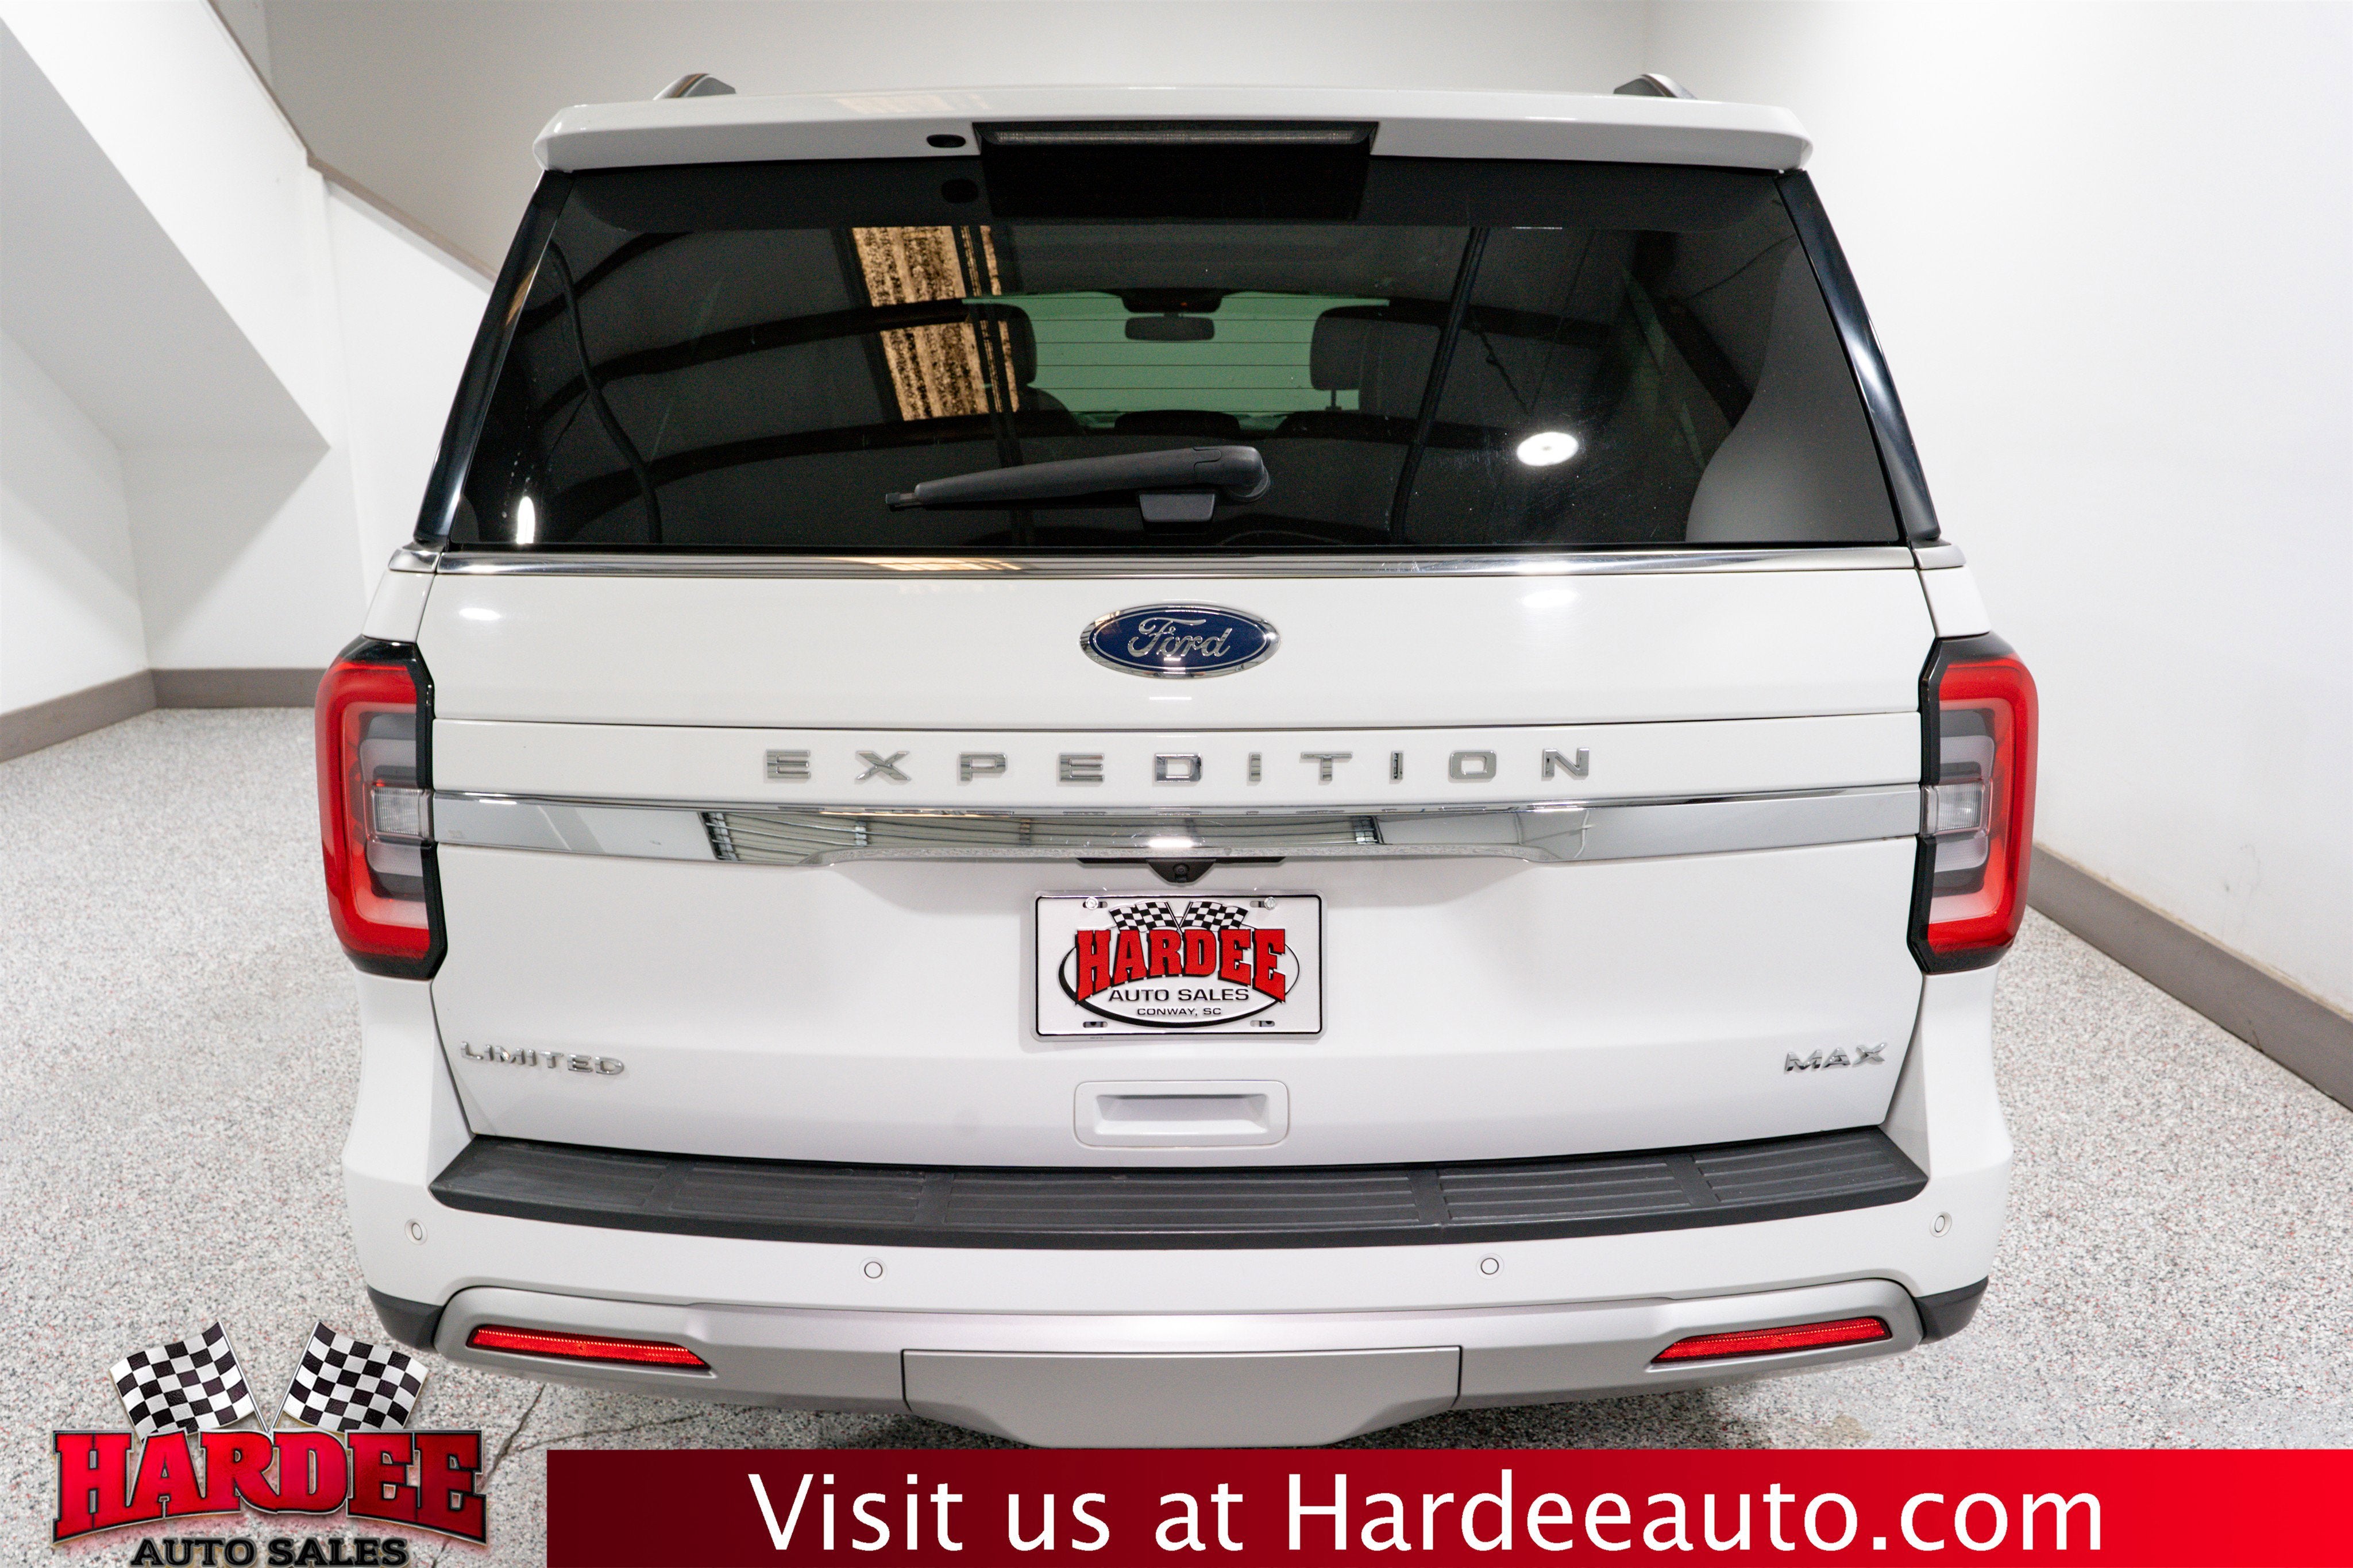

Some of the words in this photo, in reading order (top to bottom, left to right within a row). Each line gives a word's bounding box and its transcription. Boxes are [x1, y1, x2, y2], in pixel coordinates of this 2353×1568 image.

[1127, 616, 1233, 658] Ford
[766, 748, 1590, 783] EXPEDITION
[1075, 928, 1286, 1005] HARDEE
[1108, 988, 1170, 1002] AUTO
[1178, 988, 1249, 1001] SALES
[1137, 1007, 1198, 1017] CONWAY,
[1203, 1007, 1222, 1015] SC
[460, 1041, 625, 1075] LIMITED
[1784, 1042, 1887, 1073] MAX
